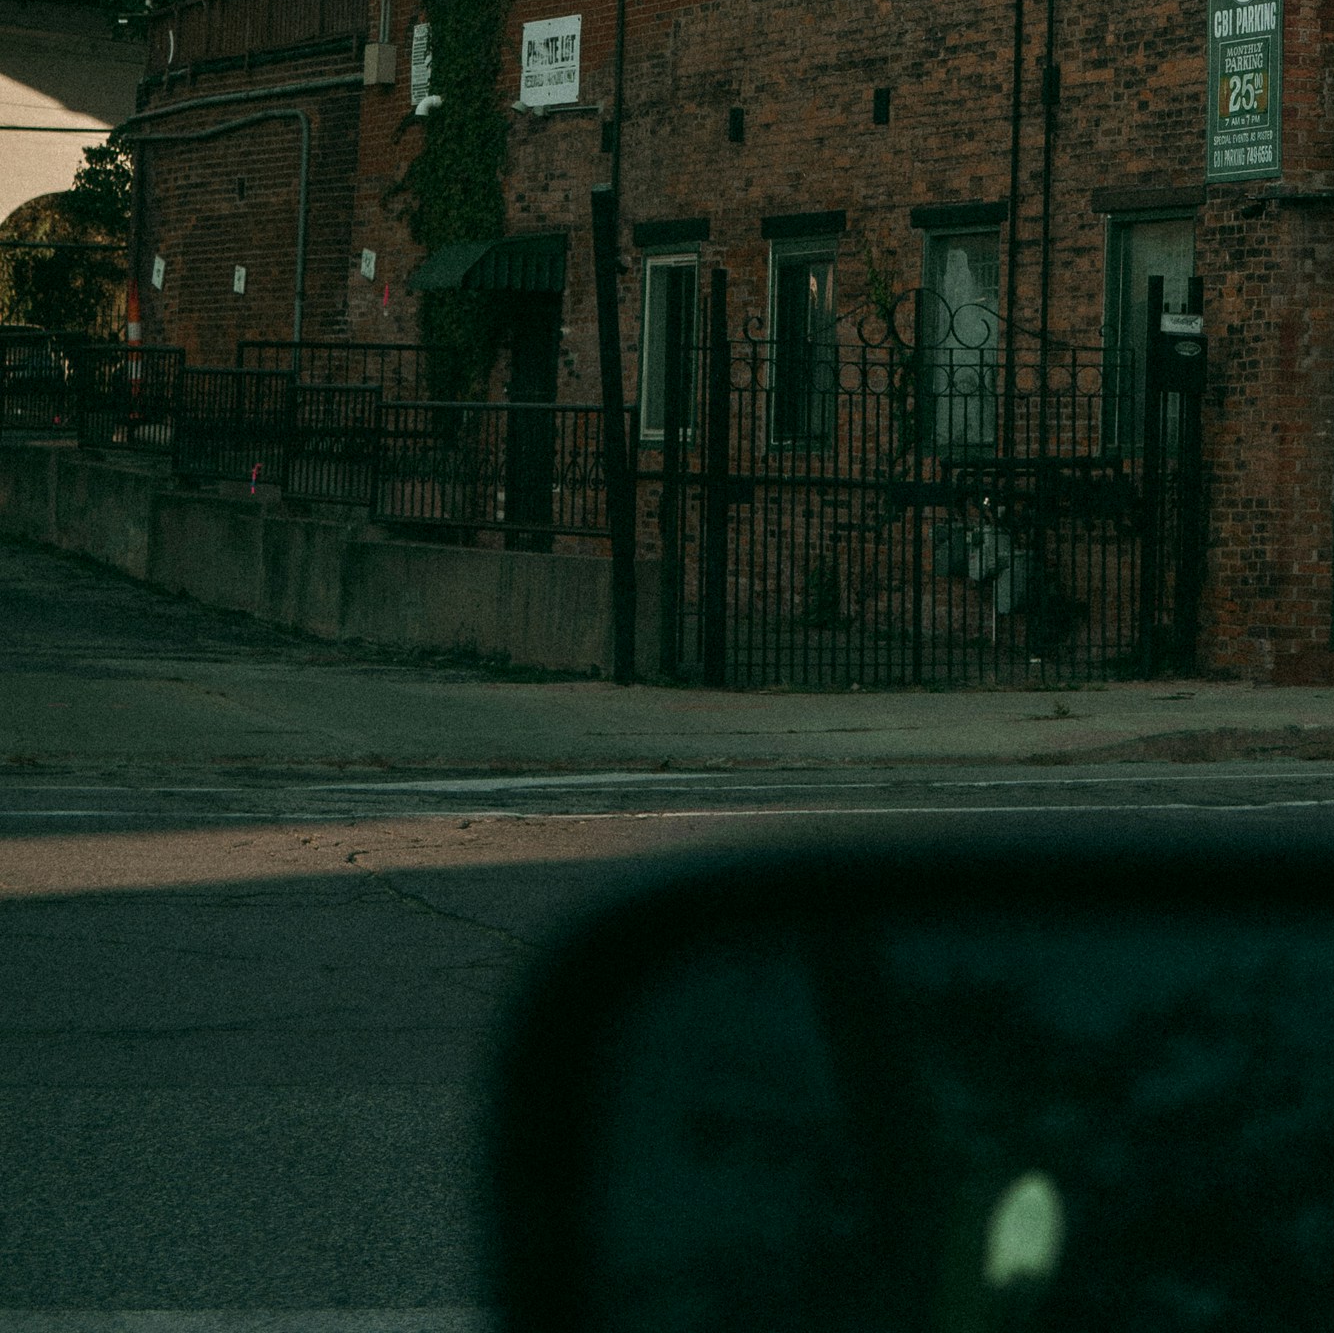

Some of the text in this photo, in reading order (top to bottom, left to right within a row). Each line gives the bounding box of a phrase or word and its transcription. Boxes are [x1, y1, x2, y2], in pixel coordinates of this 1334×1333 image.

[1214, 1, 1277, 39] CBI PARKING
[561, 34, 576, 62] LOT
[1226, 42, 1264, 57] MONTHLY
[1225, 53, 1264, 74] PARKING
[1225, 118, 1230, 127] 7
[1231, 117, 1240, 126] AM
[1245, 114, 1250, 125] 7
[1251, 115, 1261, 124] PM
[1213, 130, 1273, 146] SPECIAL EVENTS AS POSTED
[1224, 148, 1245, 167] PARKING
